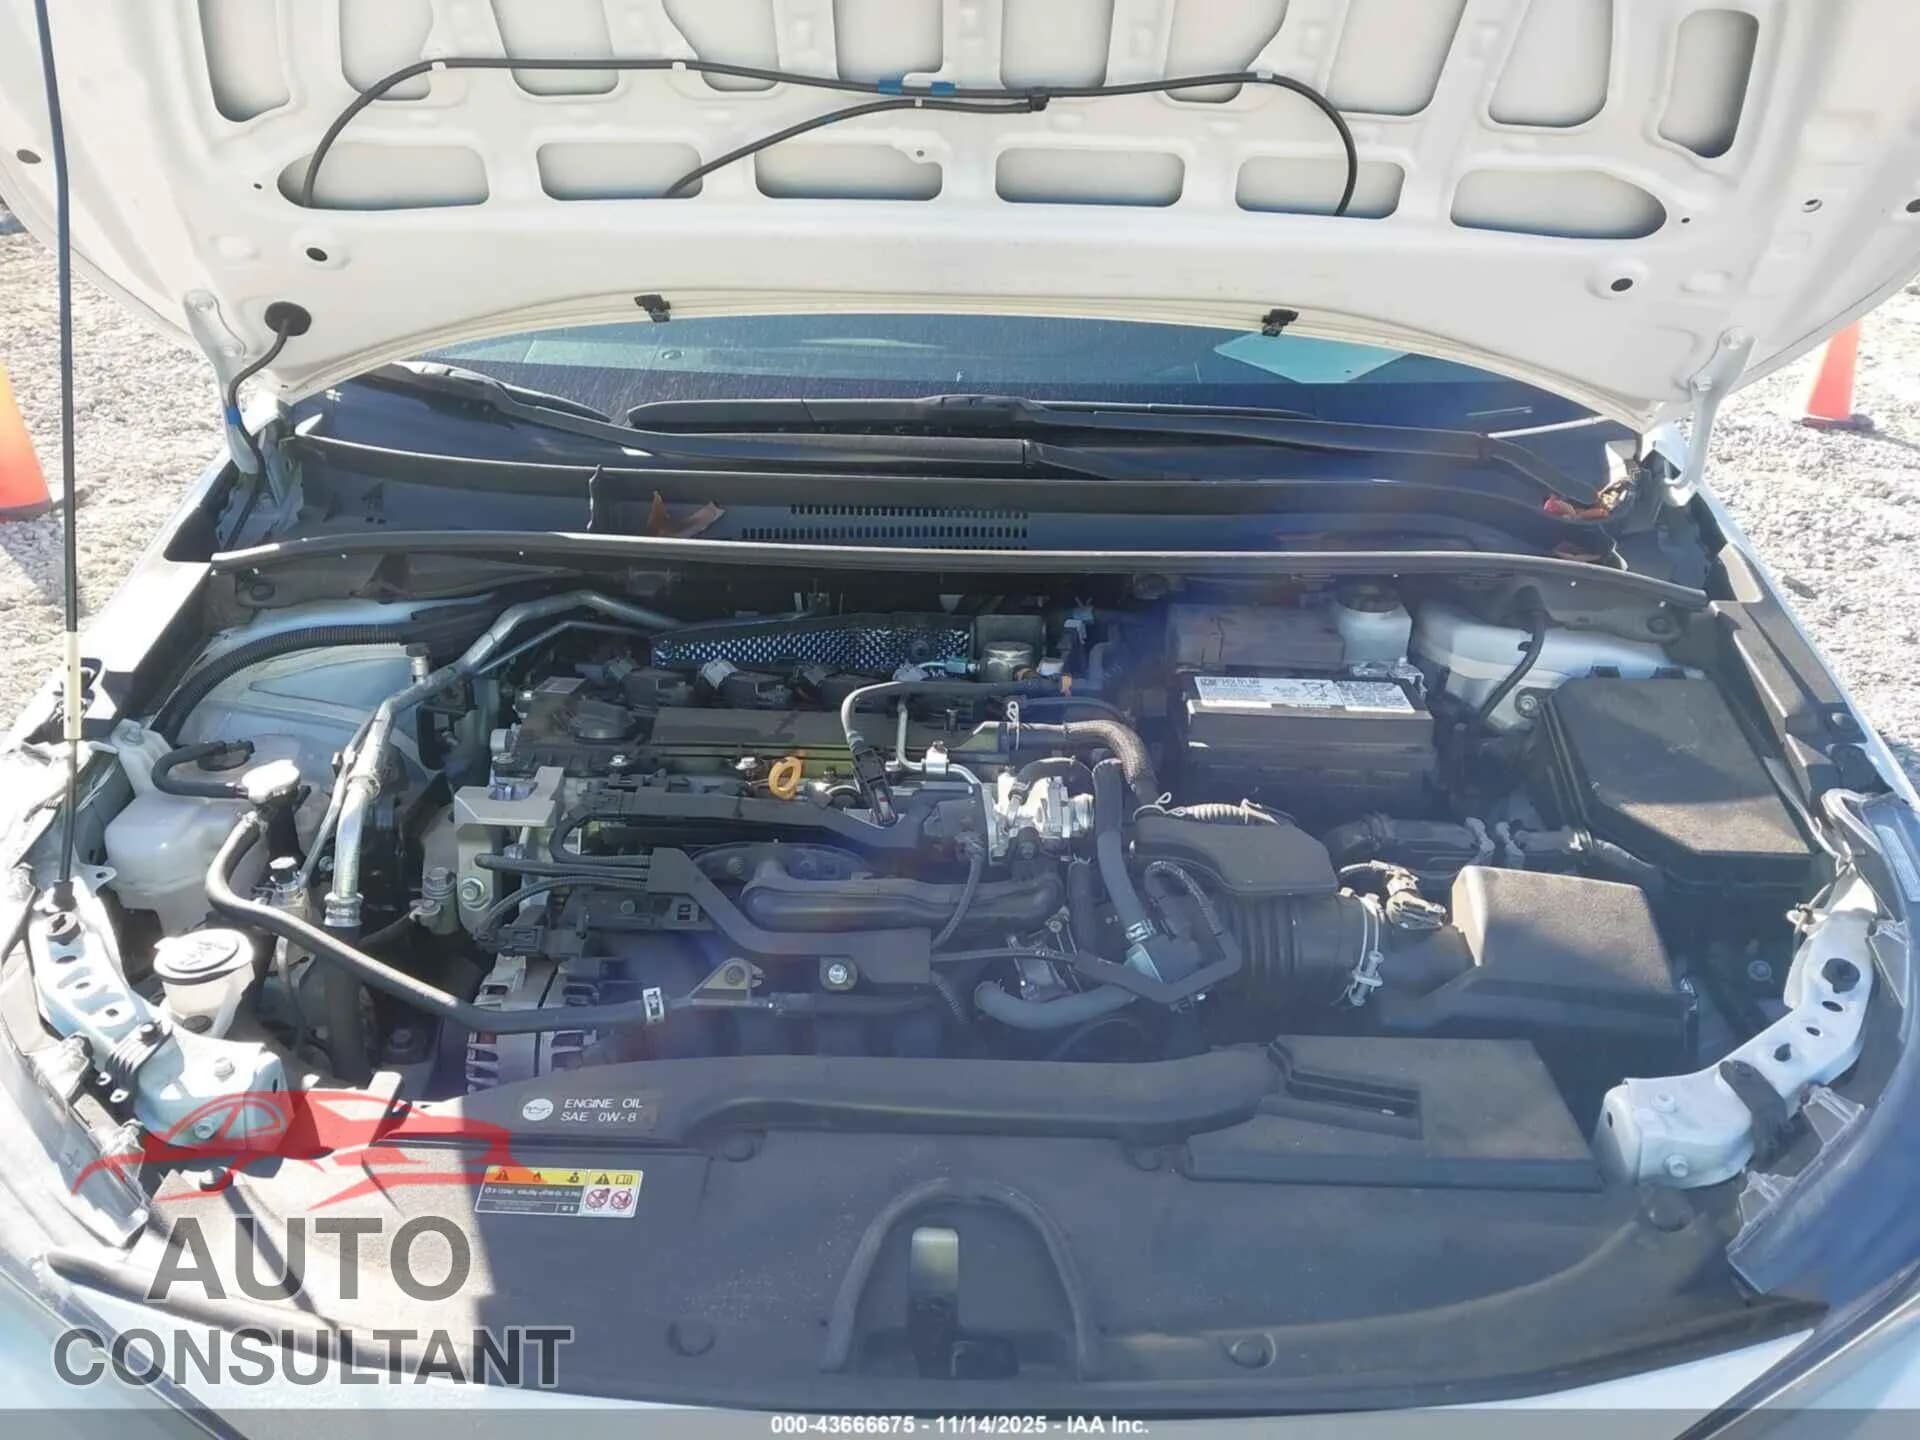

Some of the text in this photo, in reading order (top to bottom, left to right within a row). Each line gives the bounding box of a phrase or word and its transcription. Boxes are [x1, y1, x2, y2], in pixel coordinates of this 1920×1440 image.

[564, 1098, 643, 1109] ENGINE OIL
[560, 1112, 637, 1122] SAE 0W-8
